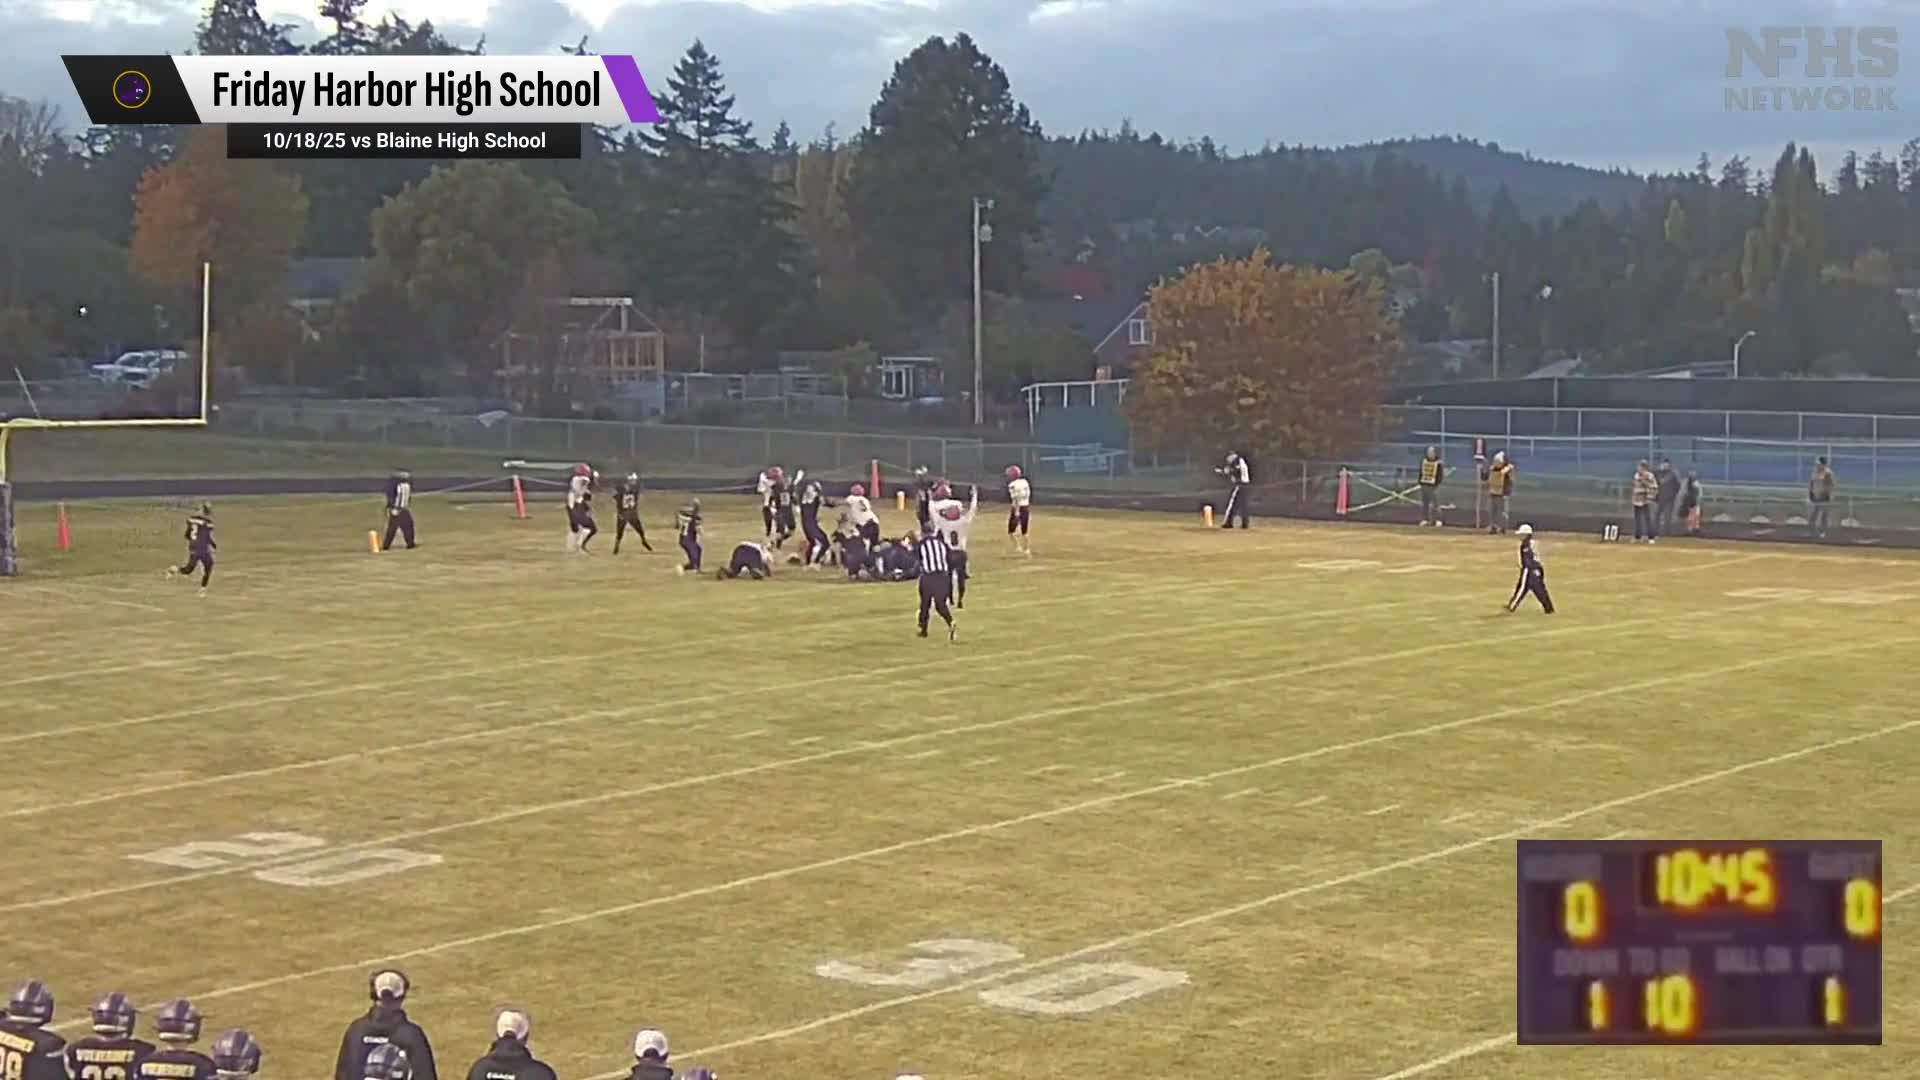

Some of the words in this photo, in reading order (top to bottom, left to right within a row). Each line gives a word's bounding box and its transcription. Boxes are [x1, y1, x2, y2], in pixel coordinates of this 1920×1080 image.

[1604, 524, 1619, 541] 10
[128, 831, 443, 887] 20
[1656, 848, 1774, 906] 10:45
[1565, 880, 1598, 940] 0
[1844, 878, 1879, 937] 0
[815, 938, 1190, 1014] 30
[1645, 974, 1695, 1034] 10
[1824, 975, 1844, 1026] 1
[1589, 980, 1608, 1031] 1
